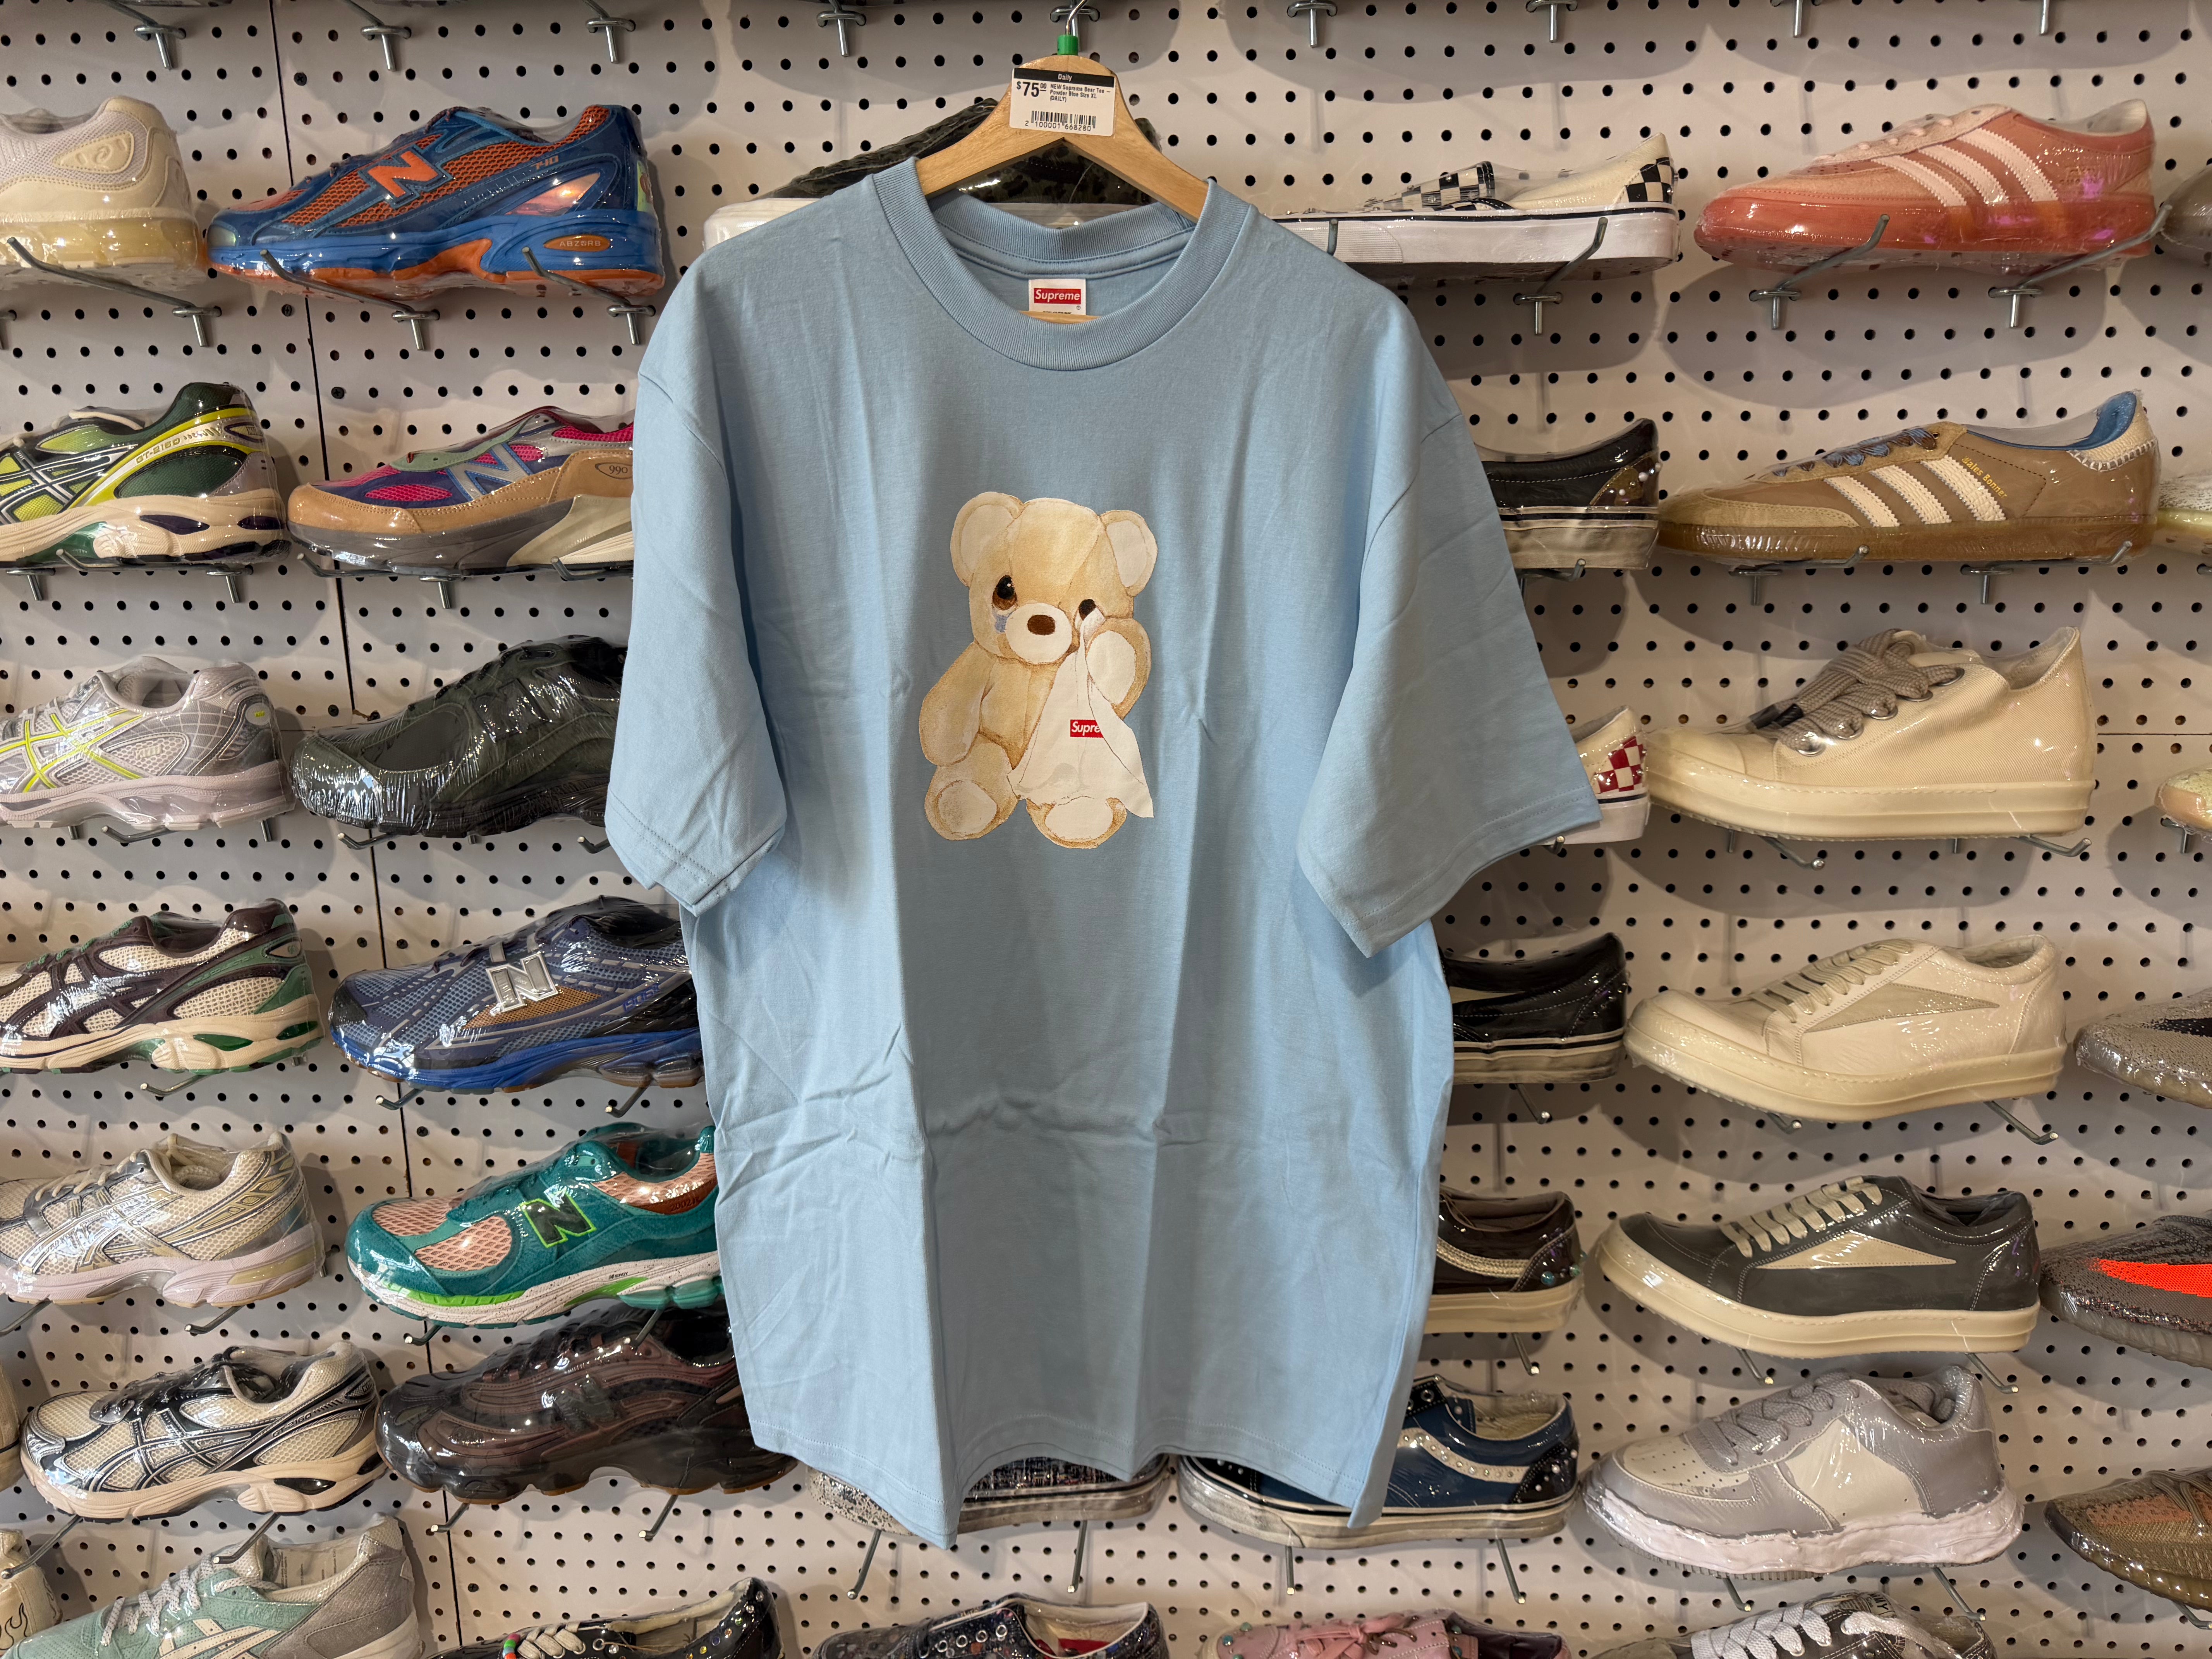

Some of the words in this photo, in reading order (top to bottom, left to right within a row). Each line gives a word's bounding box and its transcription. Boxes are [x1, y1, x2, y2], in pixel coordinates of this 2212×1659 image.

[1058, 74, 1072, 82] Daily
[1065, 124, 1091, 132] 668280
[368, 150, 438, 198] N
[1035, 289, 1080, 302] Supreme
[609, 465, 628, 475] 990
[1962, 456, 1983, 476] Wales
[1983, 474, 2007, 498] Bonner
[273, 1412, 312, 1437] GT-2160
